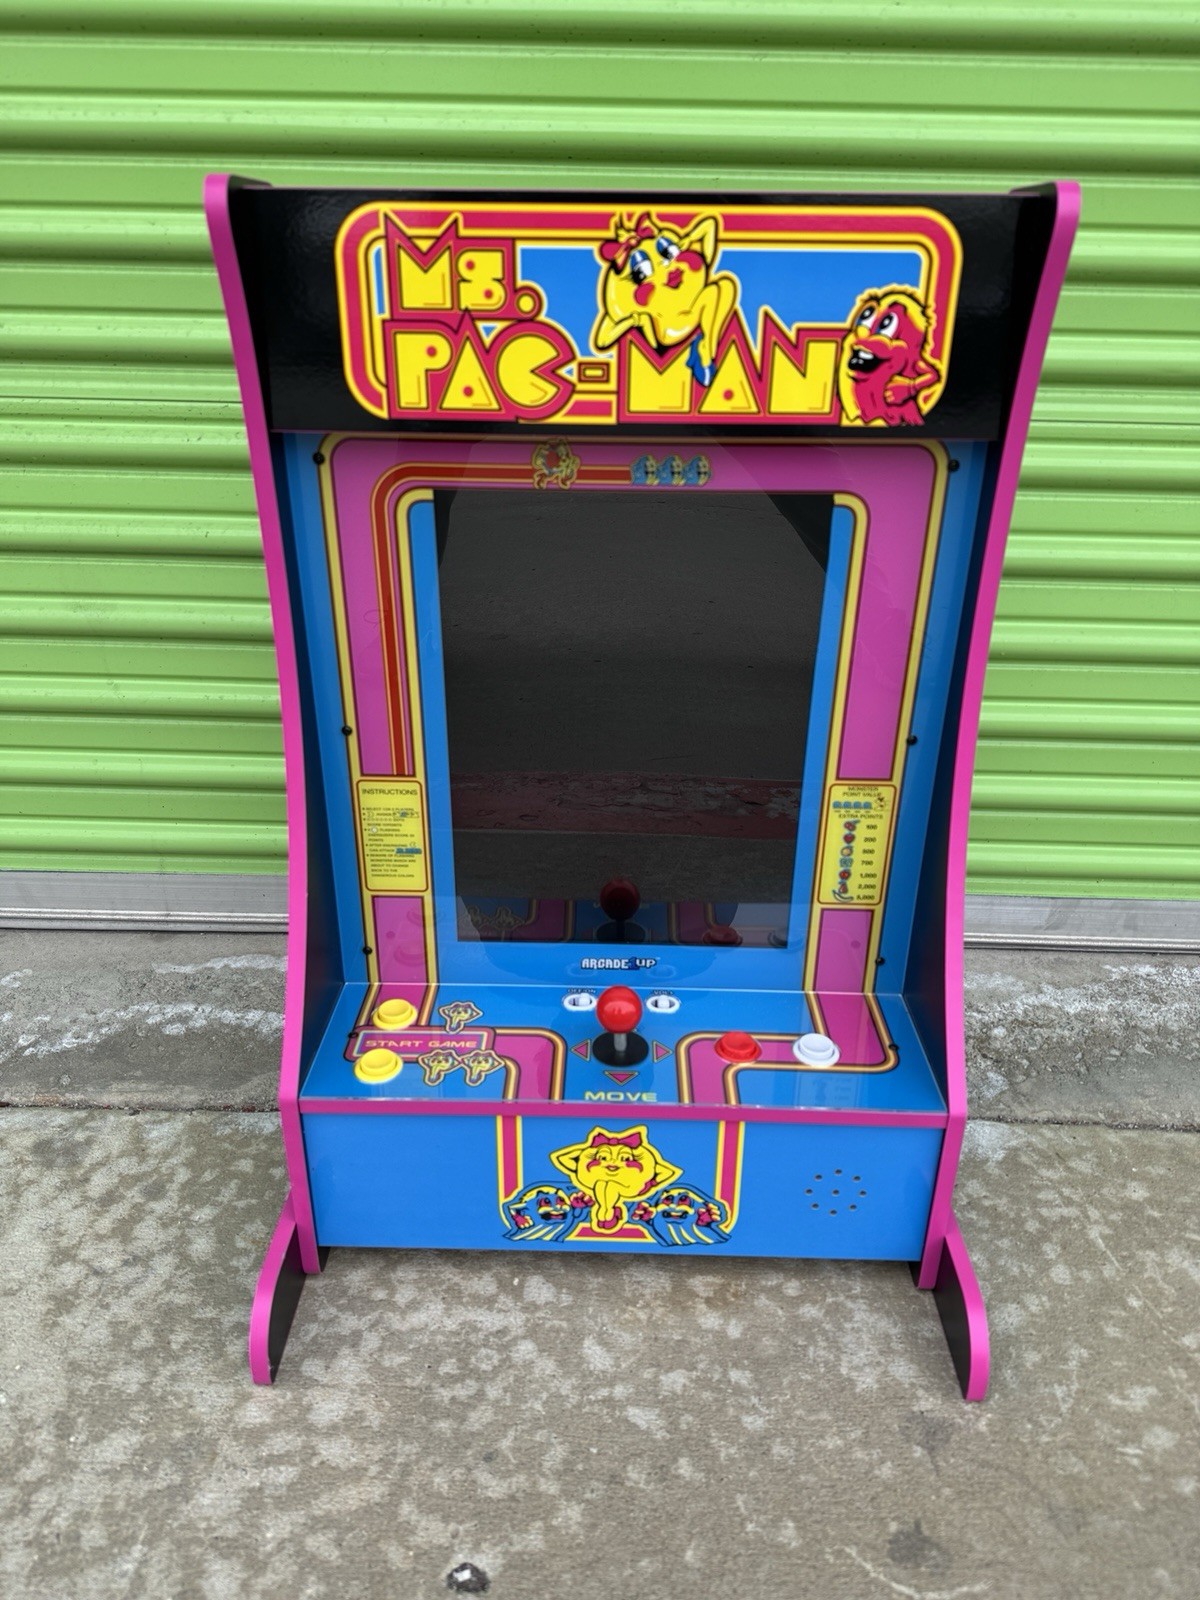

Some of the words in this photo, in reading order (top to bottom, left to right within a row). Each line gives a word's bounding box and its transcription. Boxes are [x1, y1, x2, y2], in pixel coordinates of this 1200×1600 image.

[393, 322, 840, 416] PAC-MAN
[361, 788, 418, 796] INSTRUCTIONS
[365, 1040, 423, 1048] START
[428, 1040, 477, 1048] GAME
[584, 1091, 658, 1102] MOVE
